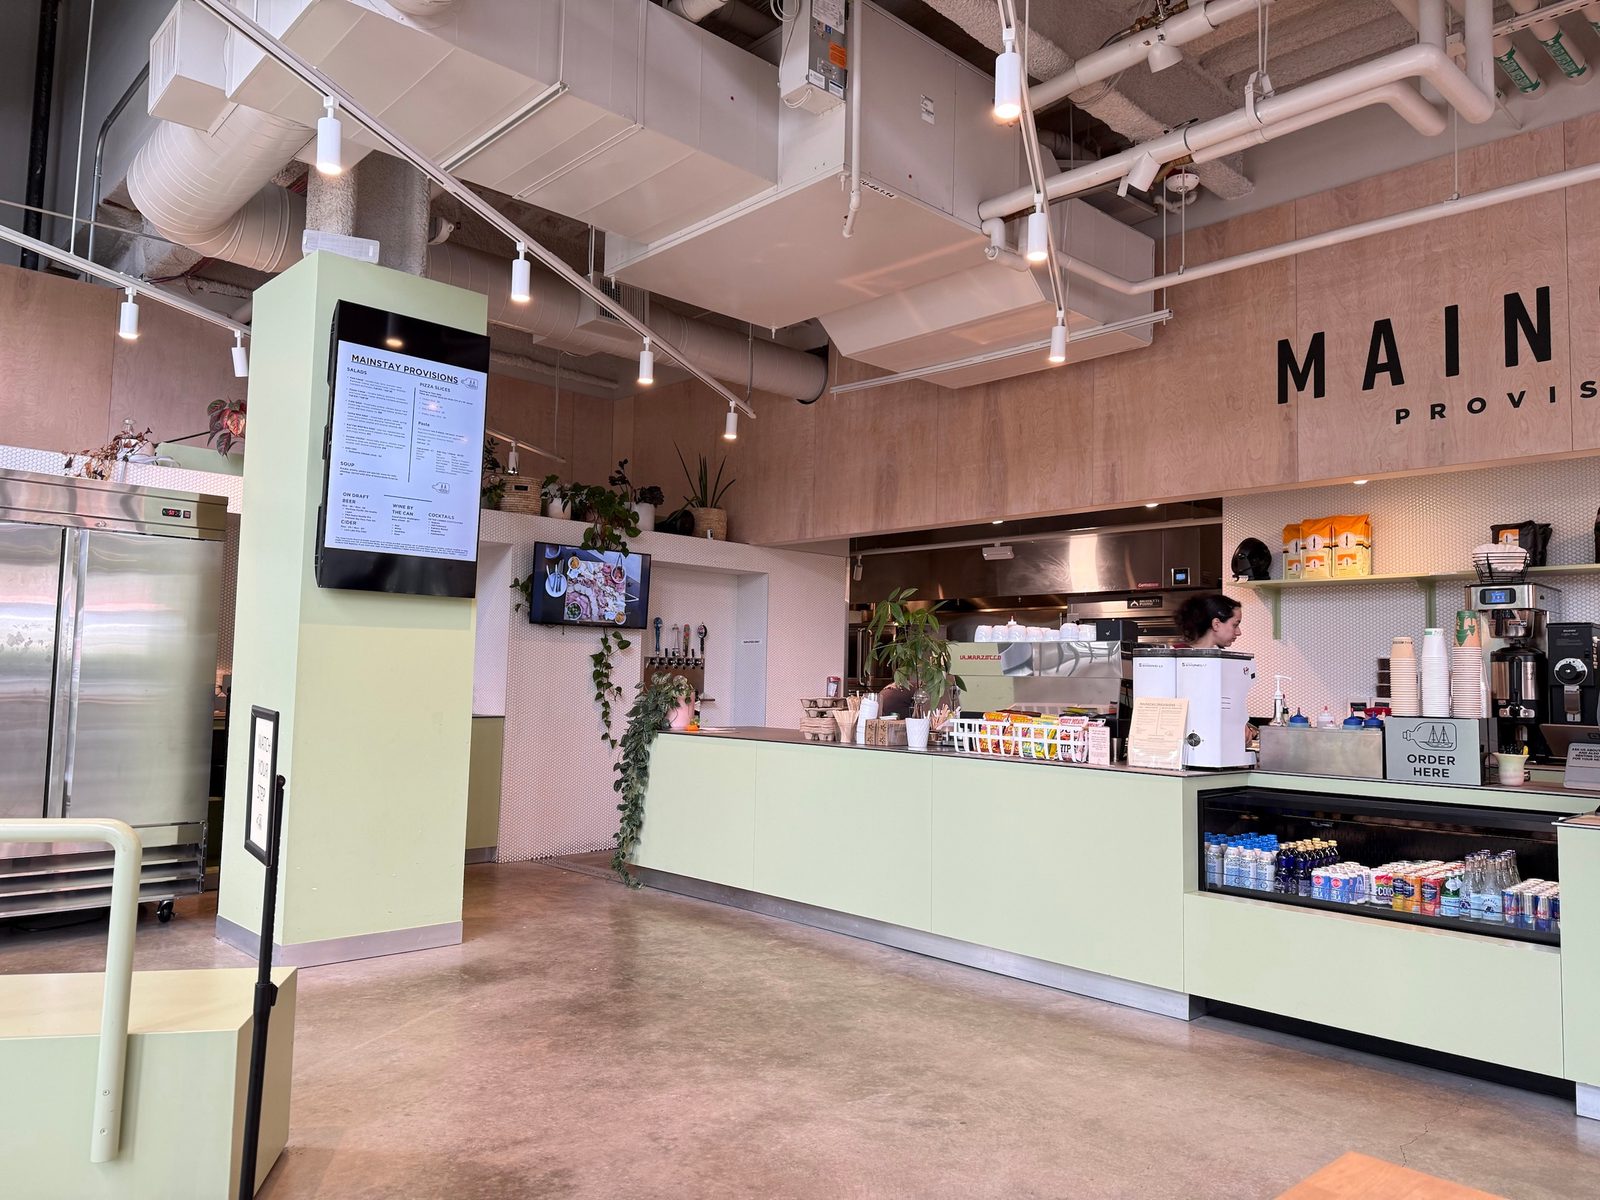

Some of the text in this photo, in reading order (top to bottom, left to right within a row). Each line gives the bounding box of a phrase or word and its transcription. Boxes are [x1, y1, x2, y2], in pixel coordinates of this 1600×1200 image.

[1277, 285, 1600, 405] MAIN
[346, 367, 368, 375] SALADS
[351, 354, 459, 384] MAINSTAY PROVISIONS
[1395, 380, 1598, 425] PROVIS
[1406, 753, 1456, 766] ORDER
[1413, 766, 1450, 779] HERE
